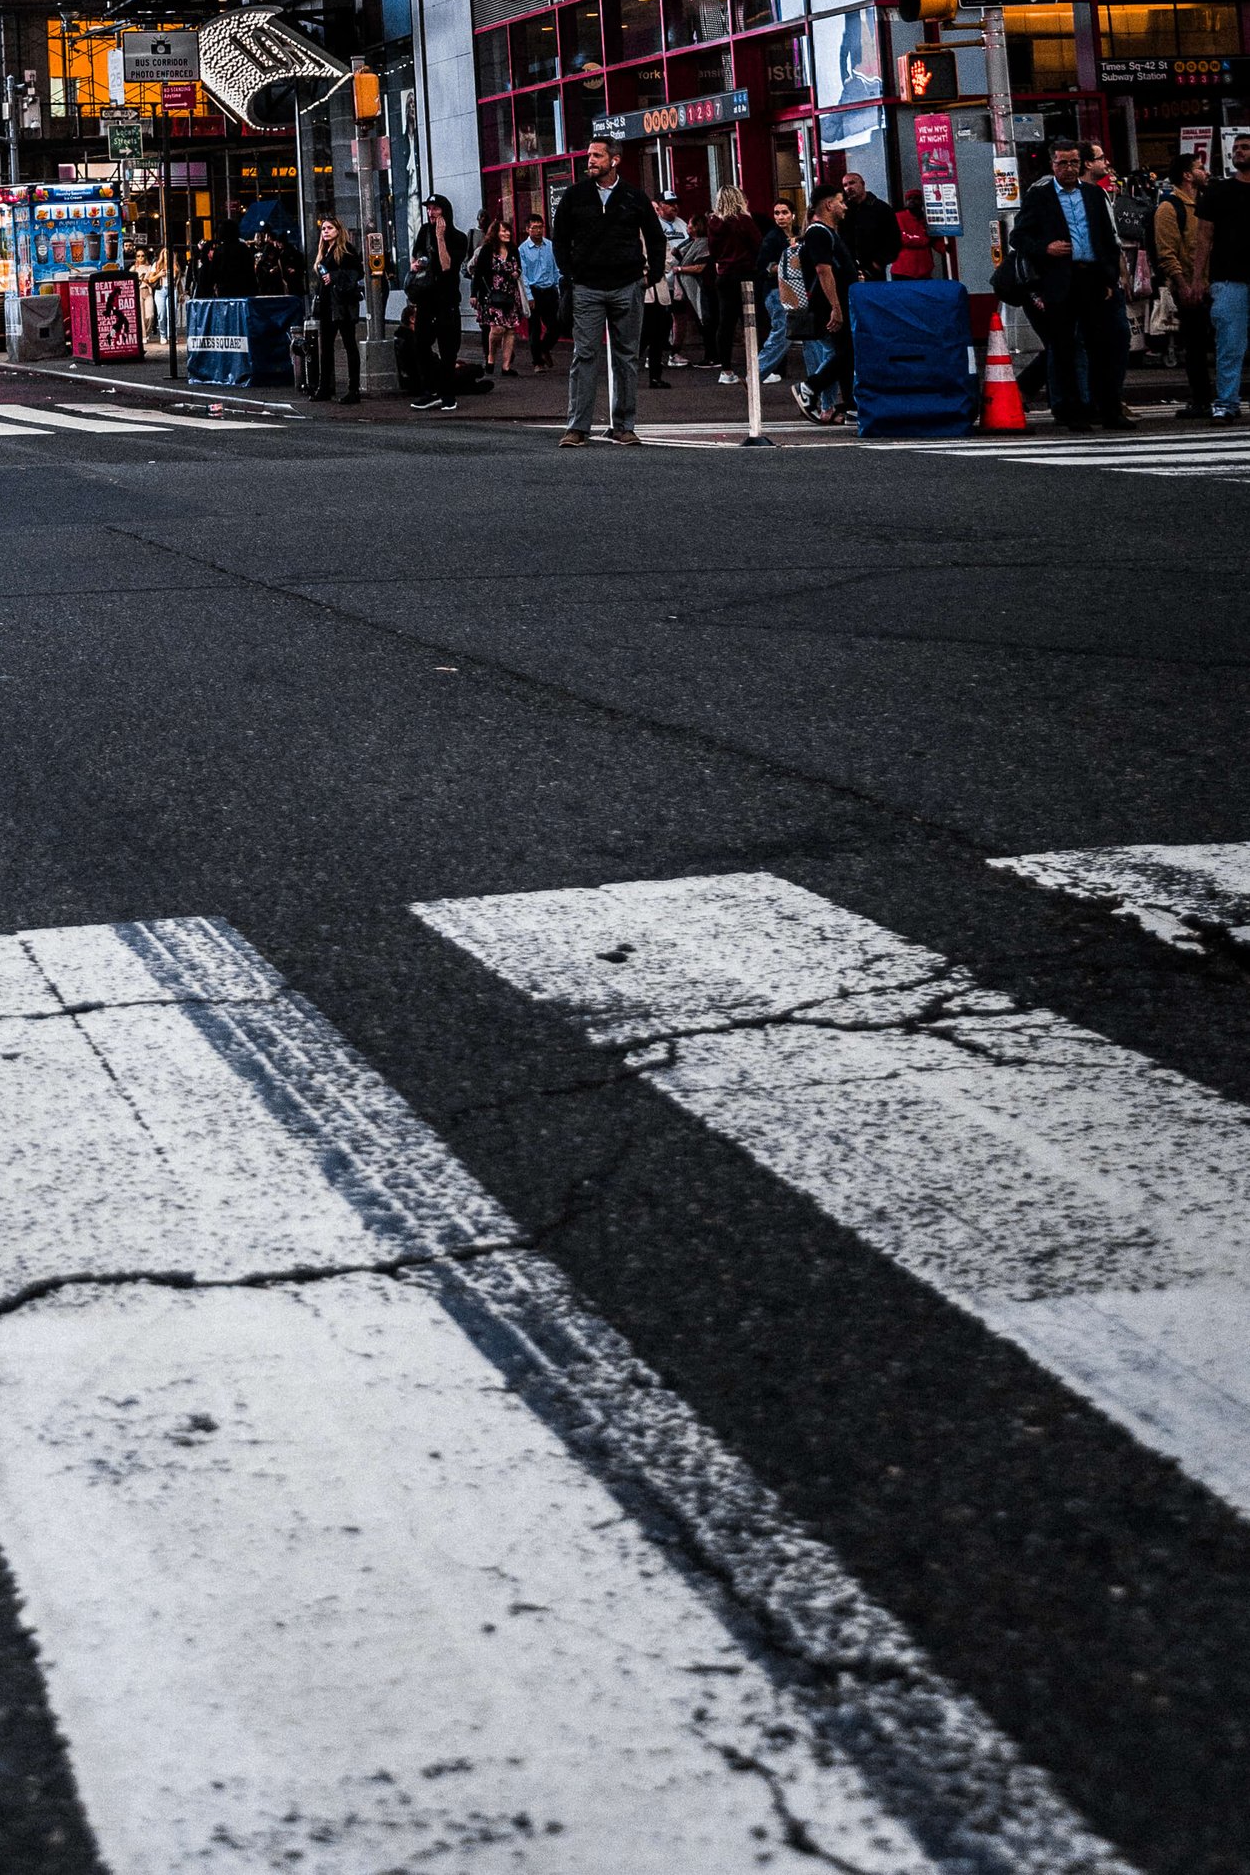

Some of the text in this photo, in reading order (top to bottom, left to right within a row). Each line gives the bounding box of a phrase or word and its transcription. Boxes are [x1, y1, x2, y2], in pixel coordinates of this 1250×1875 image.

[135, 58, 188, 67] BUS CORRIDOR
[1101, 61, 1168, 71] Times Sq-42 St
[130, 69, 194, 79] PHOTO ENFORCED
[1101, 72, 1167, 82] Subway Station
[918, 125, 948, 134] VIEW NYC
[919, 135, 926, 143] AT
[95, 282, 112, 291] BEAT
[95, 290, 112, 303] IT
[118, 298, 135, 310] BAD
[191, 337, 241, 350] TIMES SQUARE
